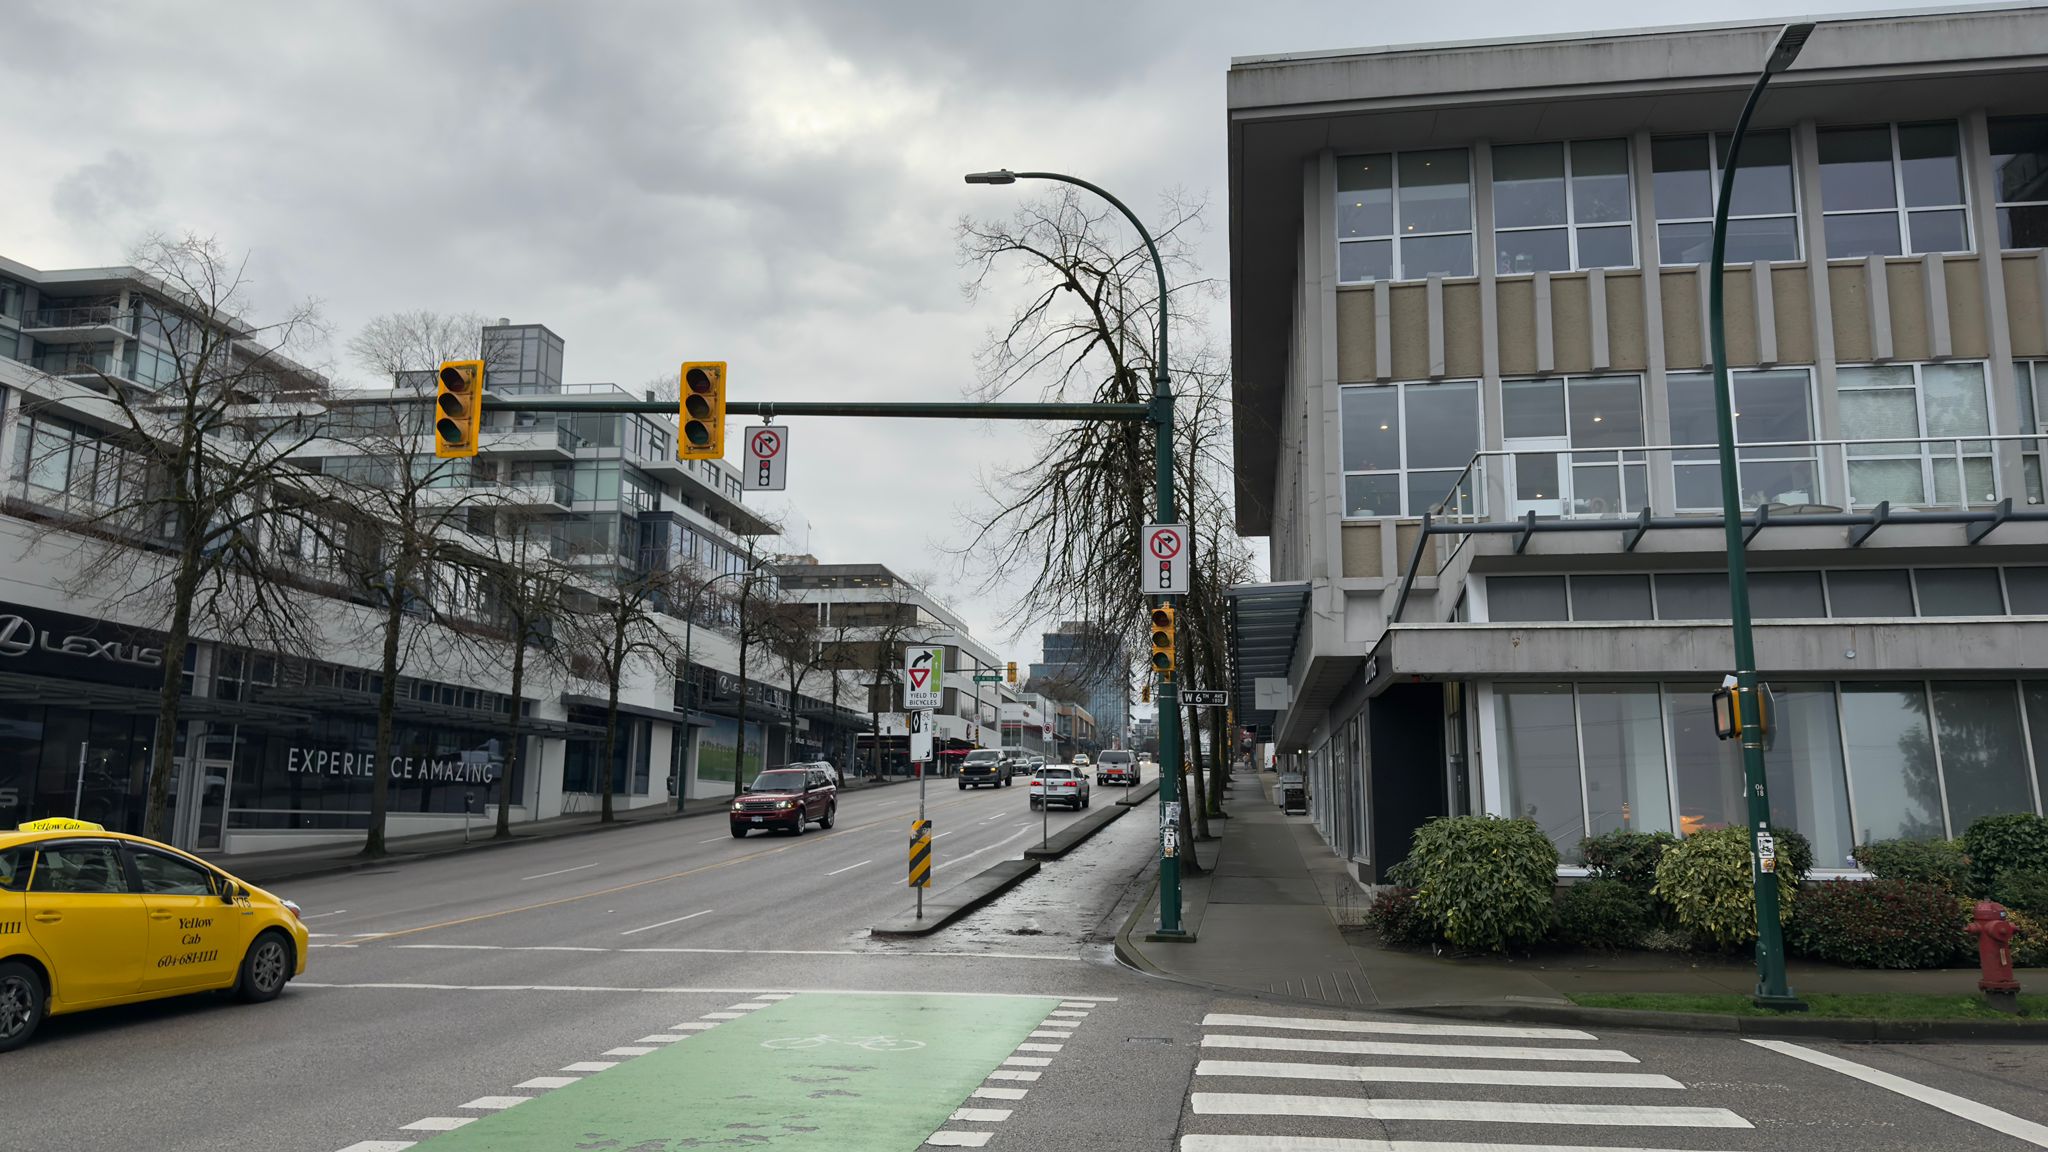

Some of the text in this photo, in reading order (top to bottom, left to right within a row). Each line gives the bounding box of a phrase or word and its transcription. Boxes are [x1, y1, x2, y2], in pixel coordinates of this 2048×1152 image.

[40, 631, 163, 667] LEXUS
[1184, 693, 1193, 702] W
[1195, 693, 1210, 703] 6TH
[287, 747, 494, 784] EXPERIECE AMAZING
[33, 822, 80, 831] Yellow Cab
[233, 896, 252, 908] Y75
[179, 918, 214, 929] Yellow
[182, 934, 202, 945] Cab
